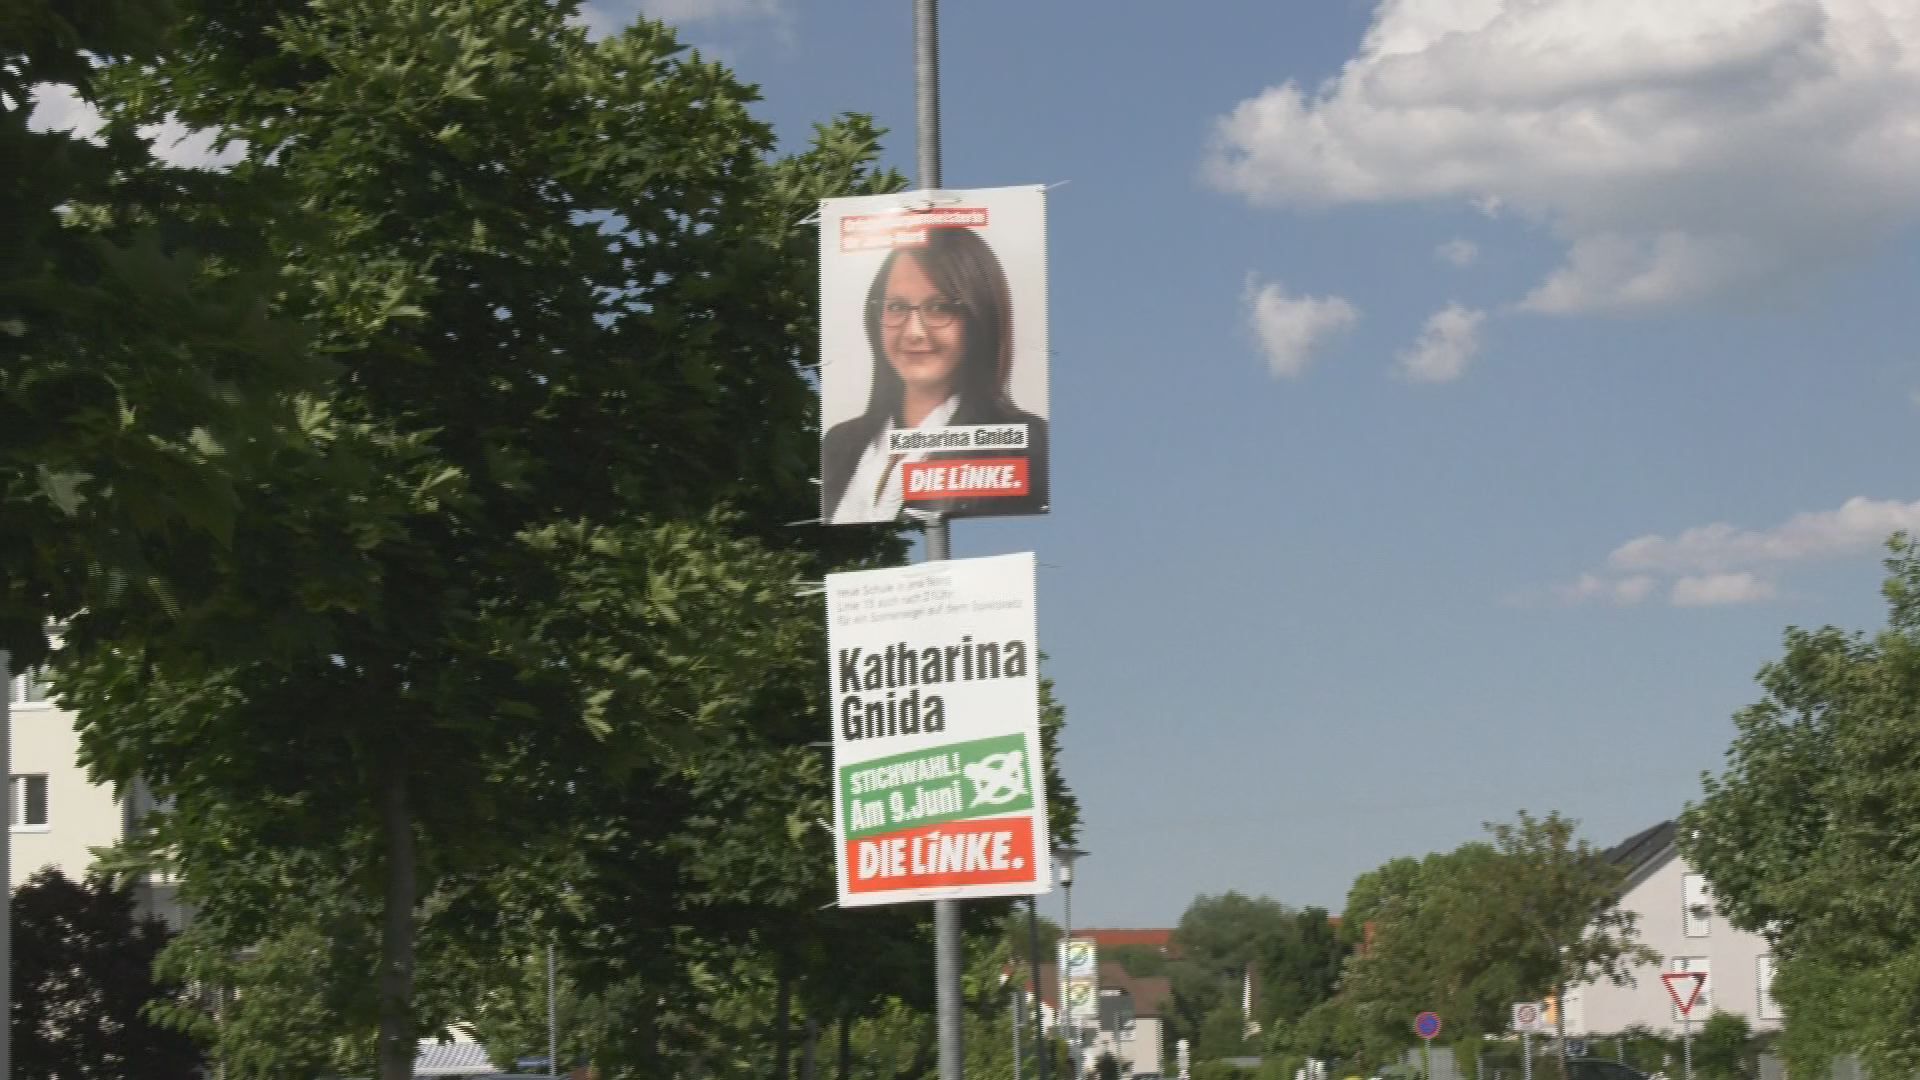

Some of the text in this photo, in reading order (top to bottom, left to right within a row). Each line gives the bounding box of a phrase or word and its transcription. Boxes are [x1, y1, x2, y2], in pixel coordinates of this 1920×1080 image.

[890, 427, 1023, 450] Katharina Gnida
[908, 467, 946, 493] DIE
[839, 635, 1027, 694] Katharina
[842, 689, 945, 741] Gnida
[851, 752, 960, 795] STICHWAHL!
[851, 797, 885, 833] Am
[858, 837, 906, 880] DIE
